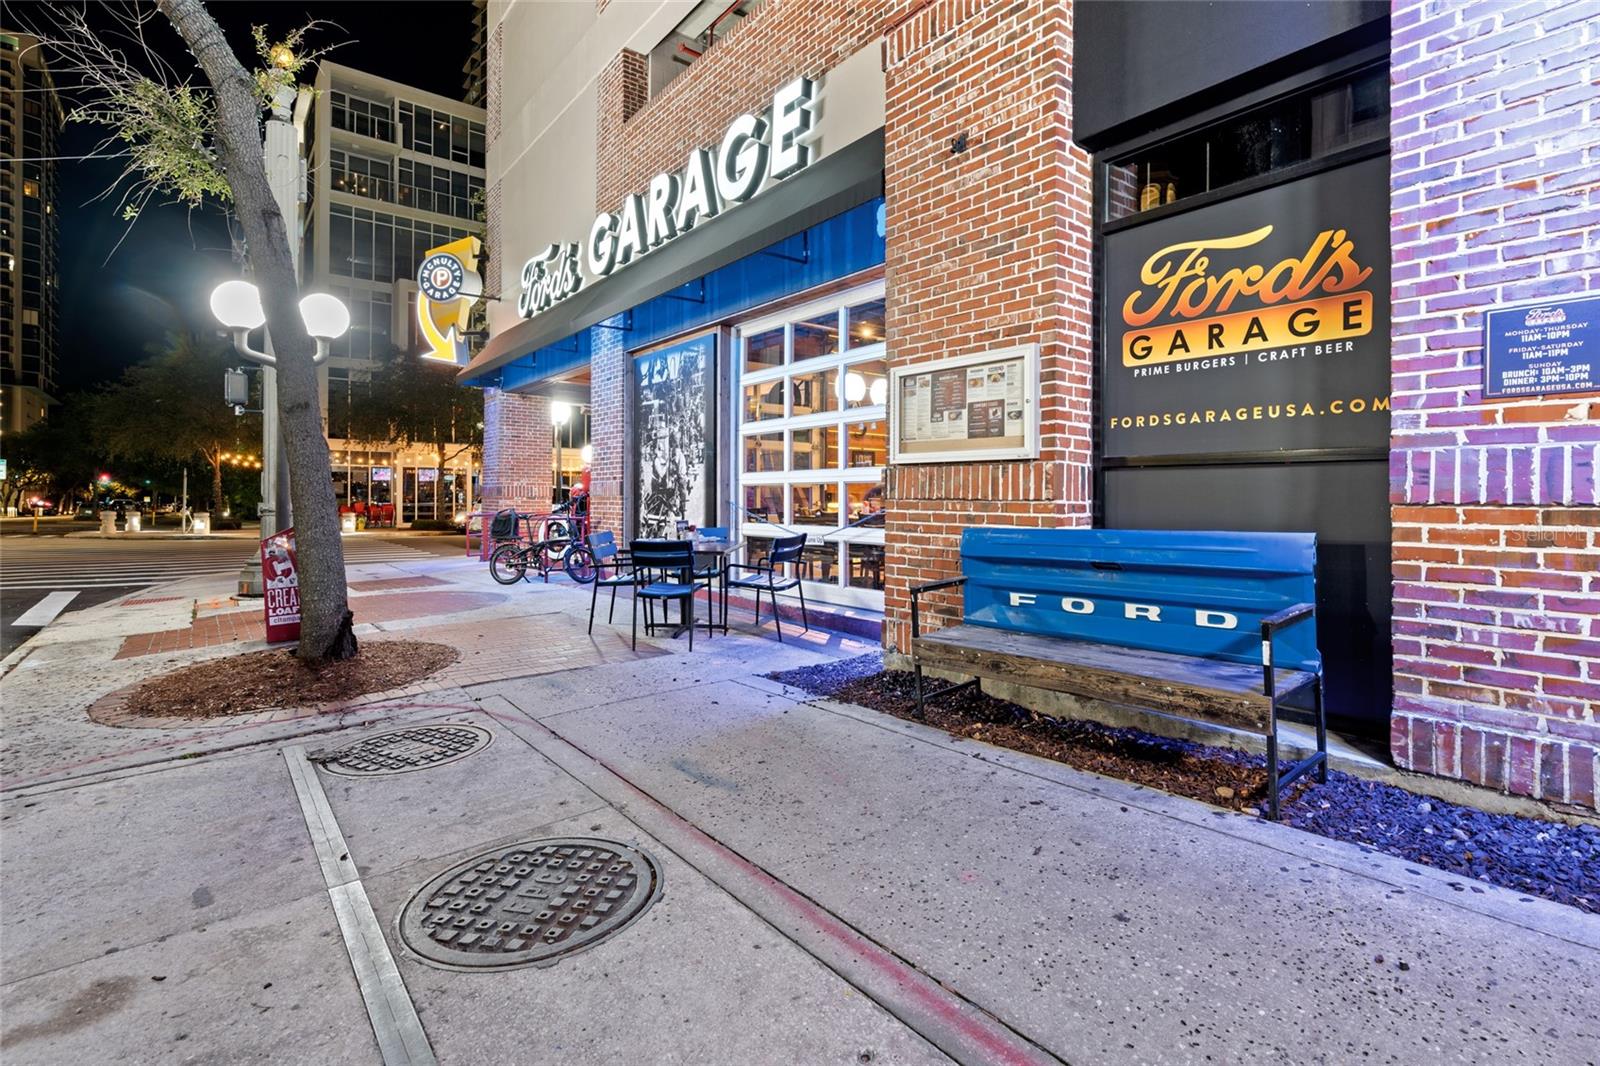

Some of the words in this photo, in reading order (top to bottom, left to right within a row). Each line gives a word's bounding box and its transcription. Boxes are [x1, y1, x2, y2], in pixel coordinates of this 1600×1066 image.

[517, 243, 583, 318] Ford's
[588, 76, 815, 275] GARAGE
[422, 280, 461, 299] GARAGE
[436, 270, 449, 286] P
[1122, 224, 1374, 327] Ford's
[1129, 299, 1363, 361] GARAGE
[1134, 365, 1170, 378] PRIME
[1176, 356, 1236, 373] BURGERS
[1257, 347, 1307, 362] CRAFT
[1315, 341, 1354, 356] BEER
[1502, 369, 1539, 379] BRUNCH:
[1528, 361, 1562, 369] SUNDAY
[1503, 377, 1538, 386] DINNER:
[1110, 396, 1391, 429] FORDSGARAGEUSA.COM
[1009, 591, 1238, 630] FORD
